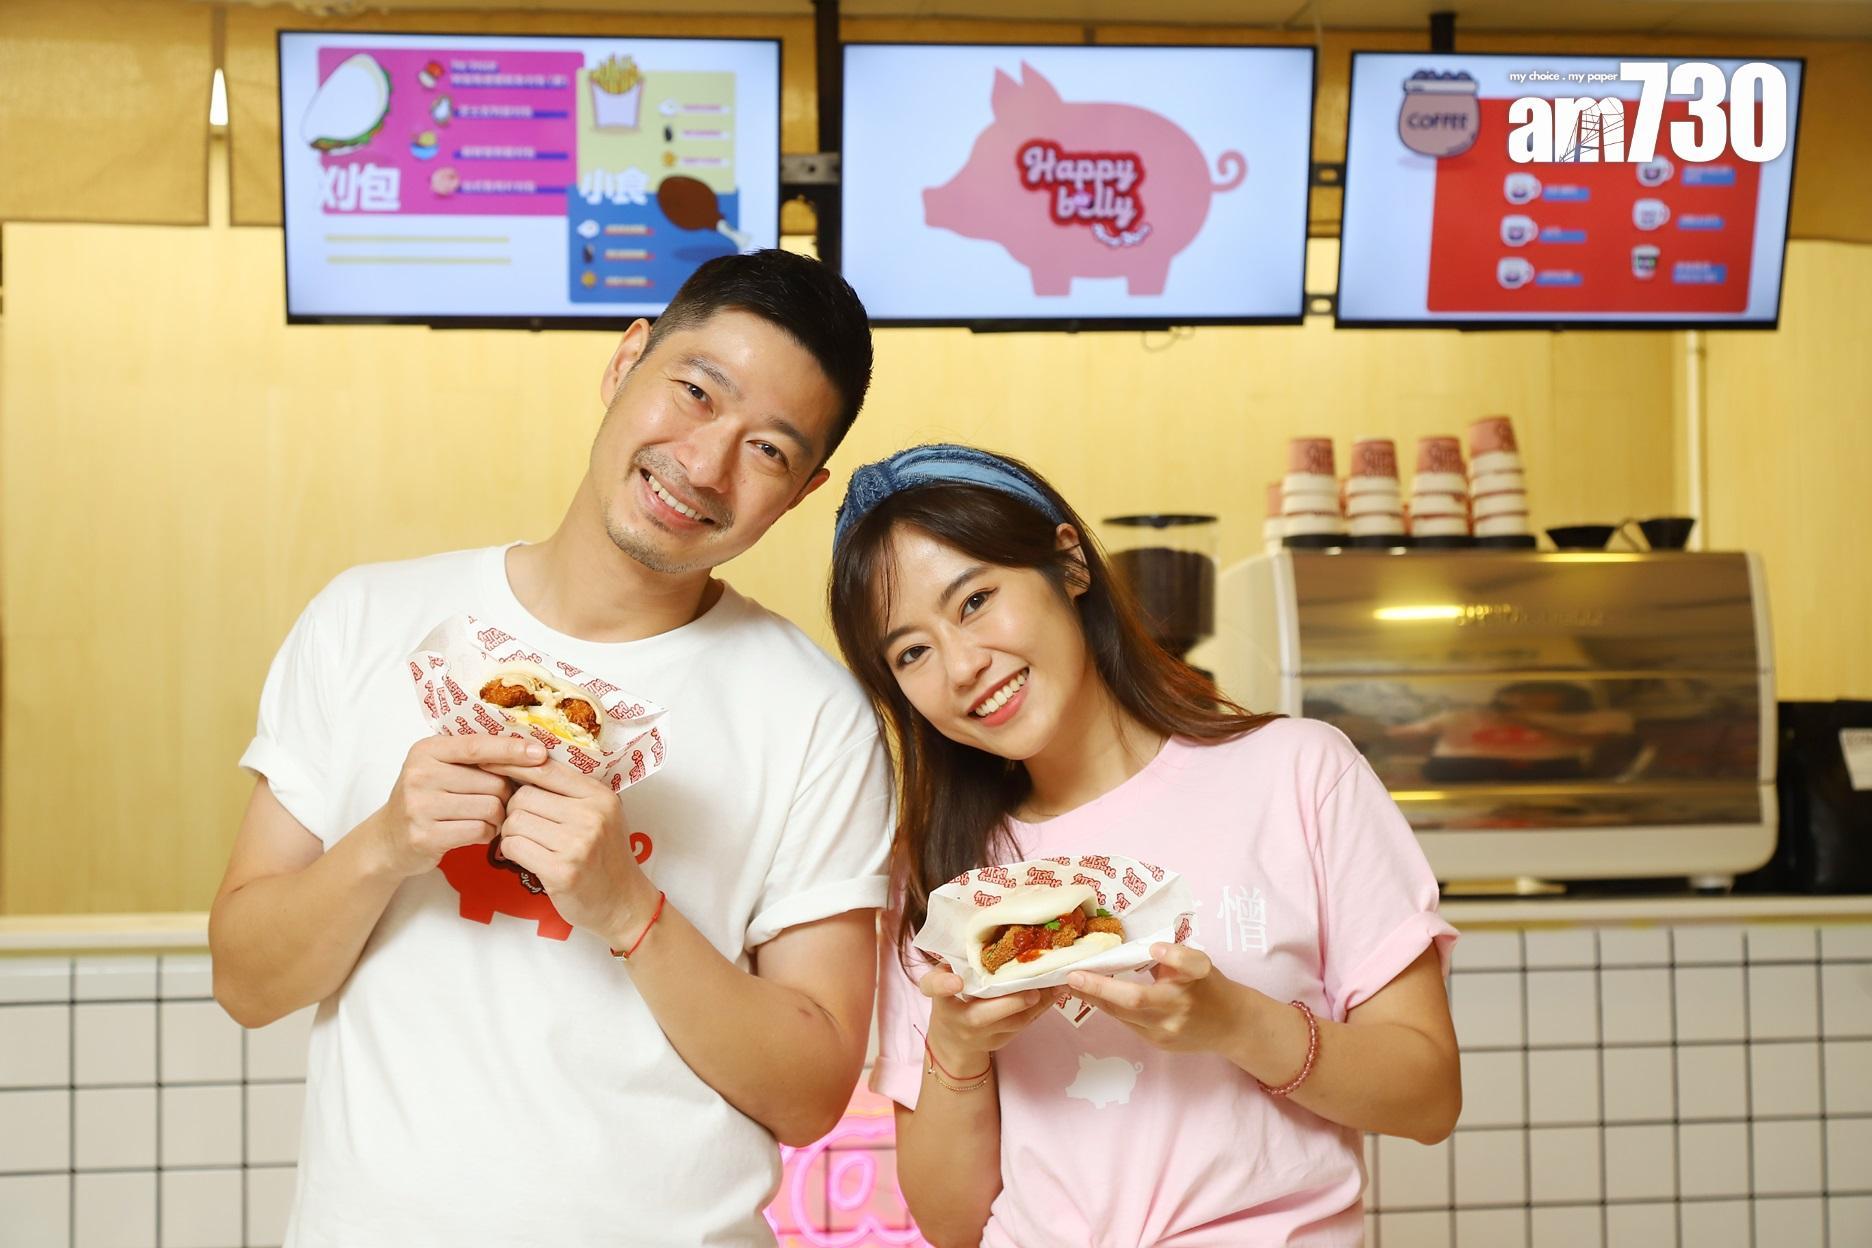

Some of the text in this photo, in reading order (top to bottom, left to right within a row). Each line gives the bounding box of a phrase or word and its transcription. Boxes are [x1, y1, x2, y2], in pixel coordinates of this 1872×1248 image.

[1022, 144, 1138, 192] Happy
[567, 745, 600, 768] Happy
[978, 873, 1017, 888] Happy
